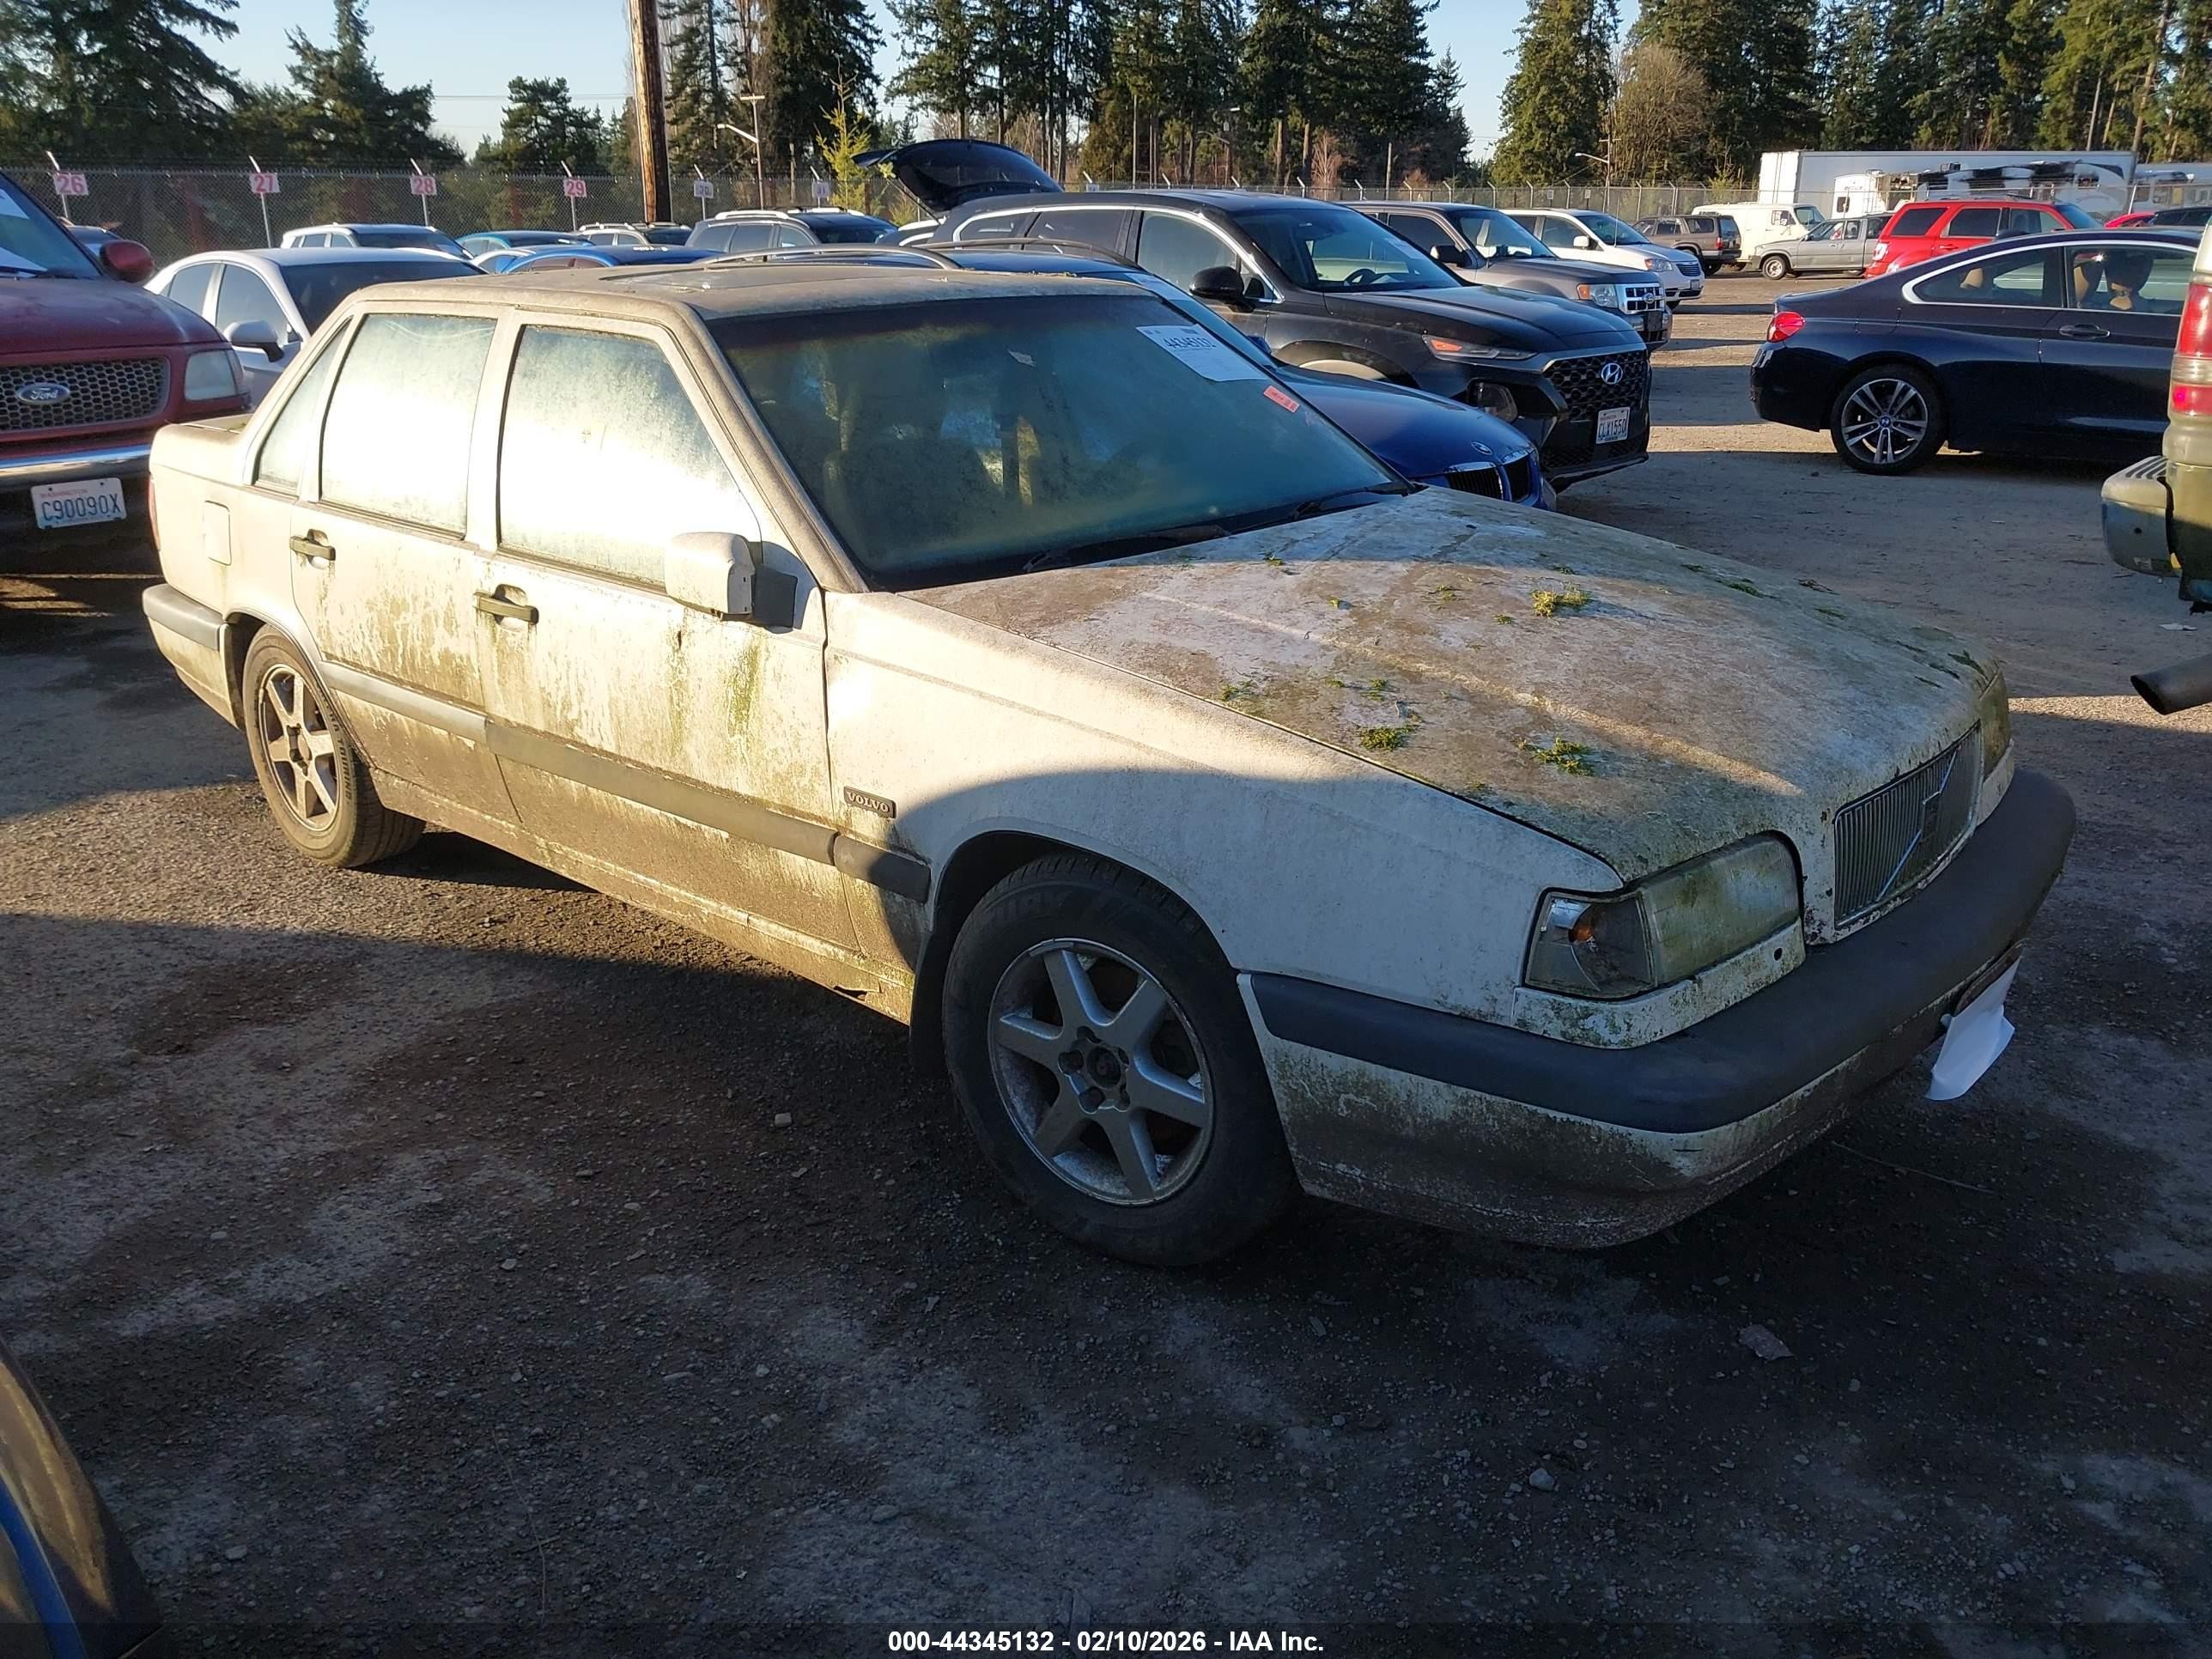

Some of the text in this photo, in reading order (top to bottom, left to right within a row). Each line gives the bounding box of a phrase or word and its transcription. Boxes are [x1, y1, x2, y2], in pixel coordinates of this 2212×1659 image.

[56, 174, 84, 194] 26
[253, 173, 274, 193] 27
[413, 177, 434, 194] 28
[566, 179, 586, 197] 29
[29, 387, 58, 400] Ford
[40, 493, 122, 521] C90090X
[845, 791, 890, 813] VOLVO
